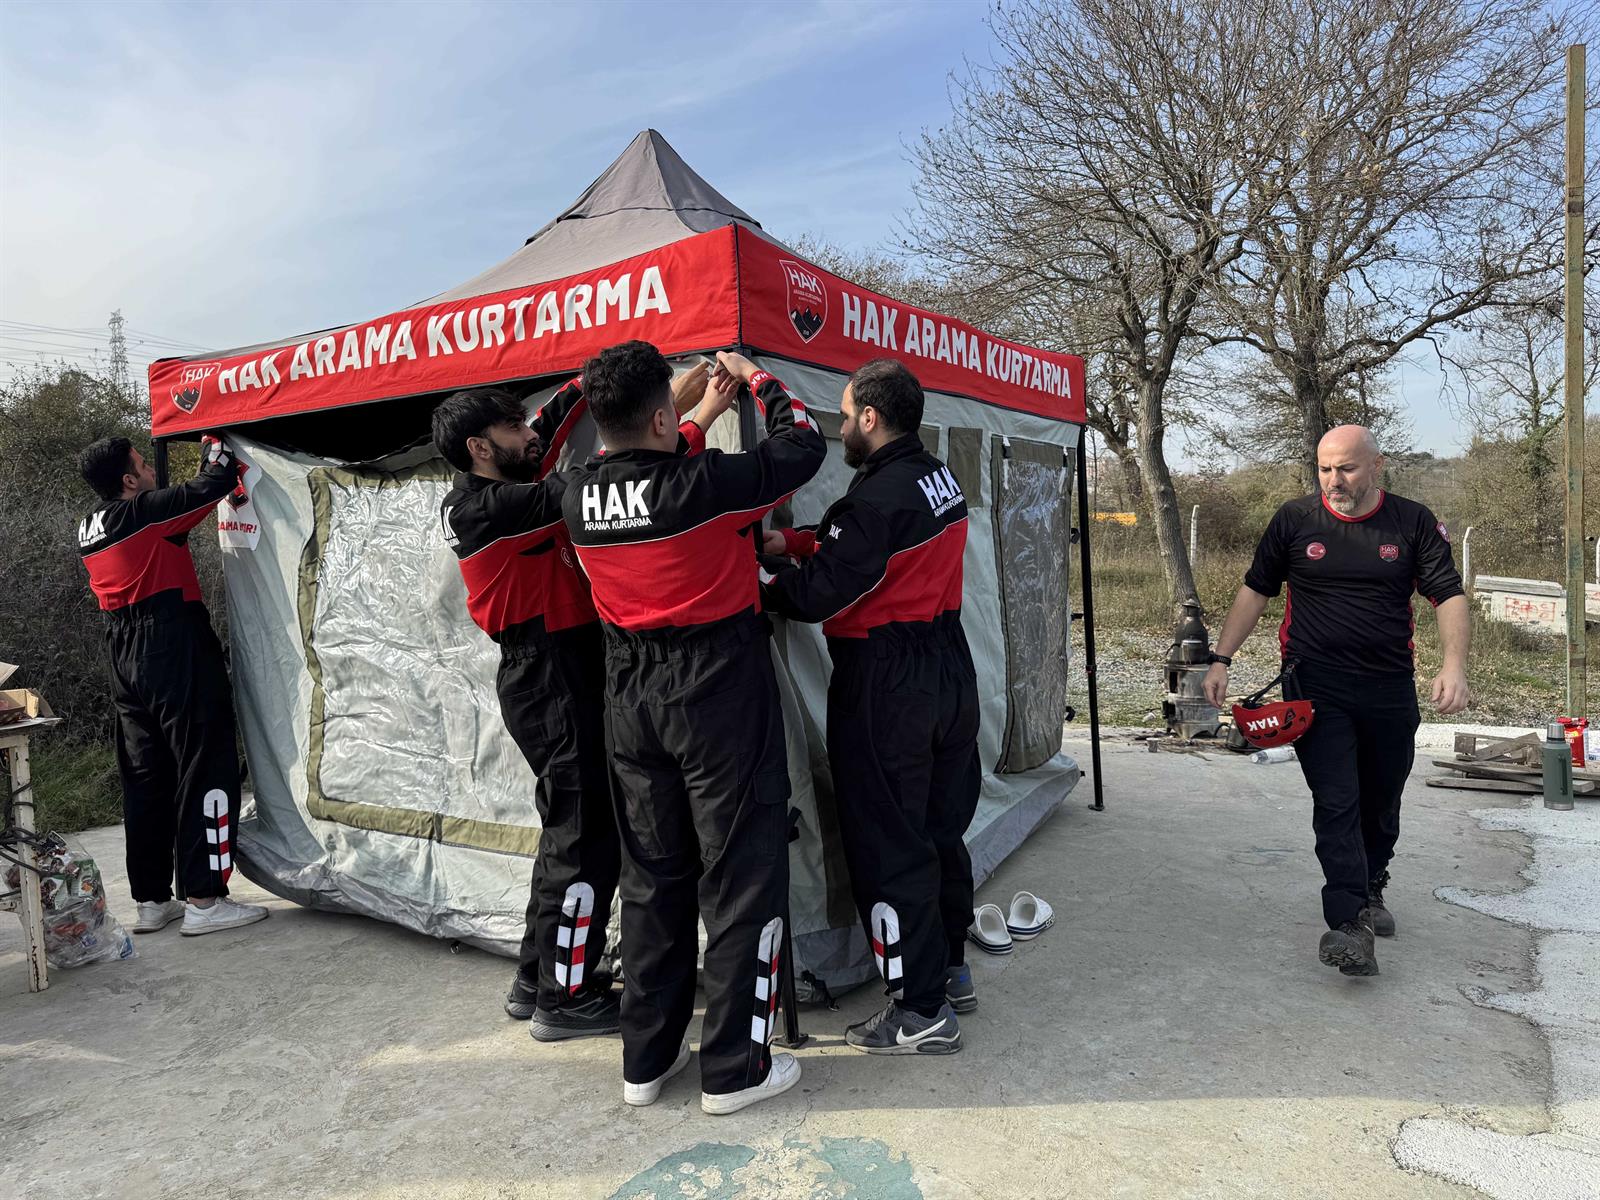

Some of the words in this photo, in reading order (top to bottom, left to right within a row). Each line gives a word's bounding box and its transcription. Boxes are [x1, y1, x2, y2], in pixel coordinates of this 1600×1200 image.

[787, 266, 822, 296] HAK
[218, 349, 287, 395] HAK
[290, 320, 417, 381] ARAMA
[427, 265, 671, 357] KURTARMA
[842, 291, 898, 351] HAK
[904, 314, 982, 374] ARAMA
[986, 340, 1072, 399] KURTARMA
[184, 366, 216, 383] HAK
[582, 479, 651, 521] HAK
[917, 465, 961, 510] HAK
[78, 510, 106, 542] HAK
[585, 521, 610, 531] ARAMA
[611, 516, 652, 530] KURTARMA
[1246, 716, 1280, 732] HAK
